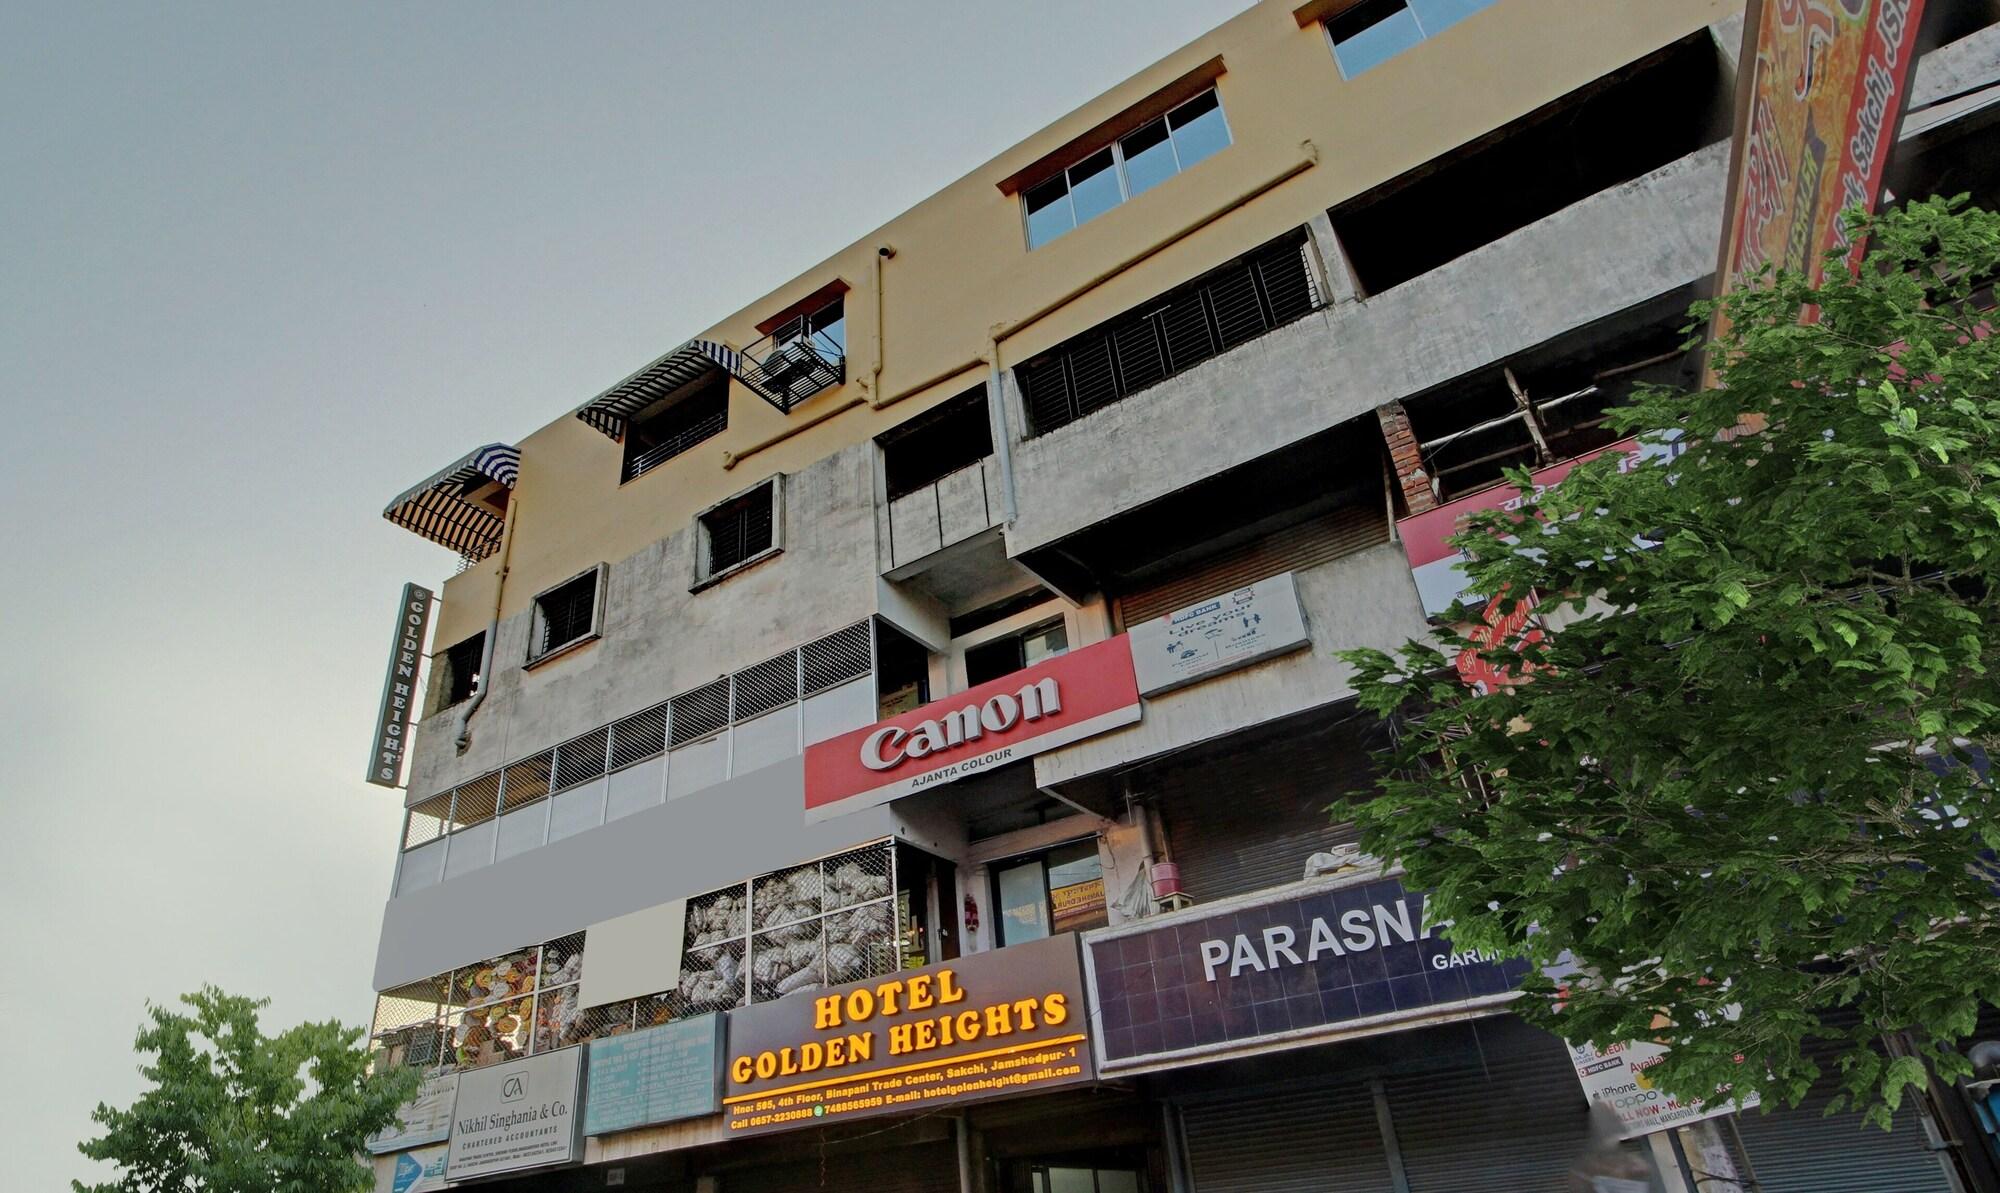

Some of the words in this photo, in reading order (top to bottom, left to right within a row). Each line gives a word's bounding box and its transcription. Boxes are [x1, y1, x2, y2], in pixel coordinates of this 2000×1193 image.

[1852, 54, 1895, 181] Sakchi,
[397, 601, 424, 679] GOLDEN
[380, 681, 410, 781] HEIGHTS
[860, 677, 1062, 770] Canon
[911, 766, 958, 788] AJANTA
[961, 748, 1013, 772] COLOUR
[814, 970, 963, 1030] HOTEL
[731, 1031, 873, 1084] GOLDEN
[889, 993, 1068, 1056] HEIGHTS
[778, 1096, 794, 1107] 4th
[796, 1093, 823, 1104] Floor,
[826, 1084, 869, 1099] Binapani
[872, 1078, 903, 1091] Trade
[905, 1072, 944, 1086] Center,
[946, 1063, 988, 1078] Sakchi,
[1068, 1047, 1077, 1058] 1
[1603, 1059, 1621, 1069] BANK
[503, 1077, 523, 1098] CA
[1601, 1082, 1637, 1098] iPhone
[1615, 1091, 1658, 1109] oppo
[457, 1115, 489, 1136] Nikhil
[488, 1105, 537, 1131] Singhania
[539, 1103, 549, 1119] &
[551, 1100, 568, 1117] Co.
[730, 1119, 748, 1130] Call
[885, 1090, 921, 1105] E-mail:
[1636, 1104, 1660, 1118] NOW
[462, 1136, 503, 1150] CHARTERED
[505, 1125, 558, 1142] ACCOUNTANTS
